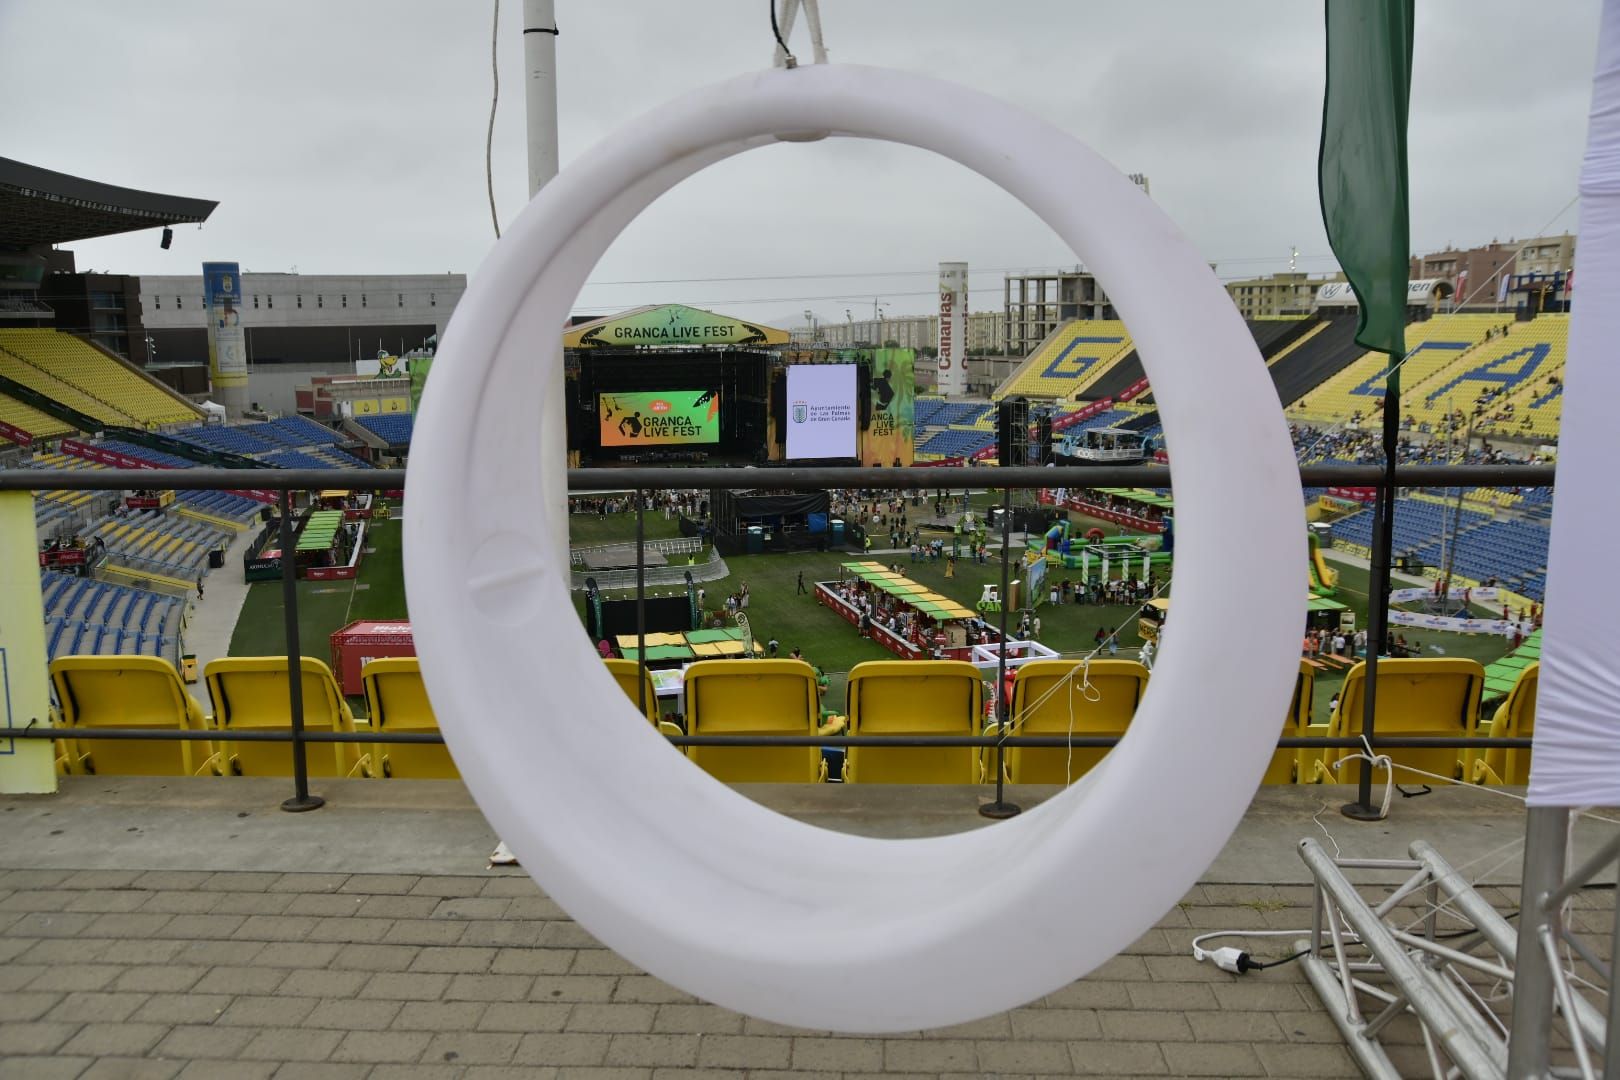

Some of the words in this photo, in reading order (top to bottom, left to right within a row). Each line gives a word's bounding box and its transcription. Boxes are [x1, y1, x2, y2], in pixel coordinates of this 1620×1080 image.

[614, 326, 669, 339] GRANCA
[672, 326, 701, 338] LIVE
[704, 325, 735, 337] FEST
[643, 416, 692, 427] GRANCA
[877, 421, 894, 429] LIVE
[643, 427, 670, 438] LIVE
[673, 426, 702, 436] FEST
